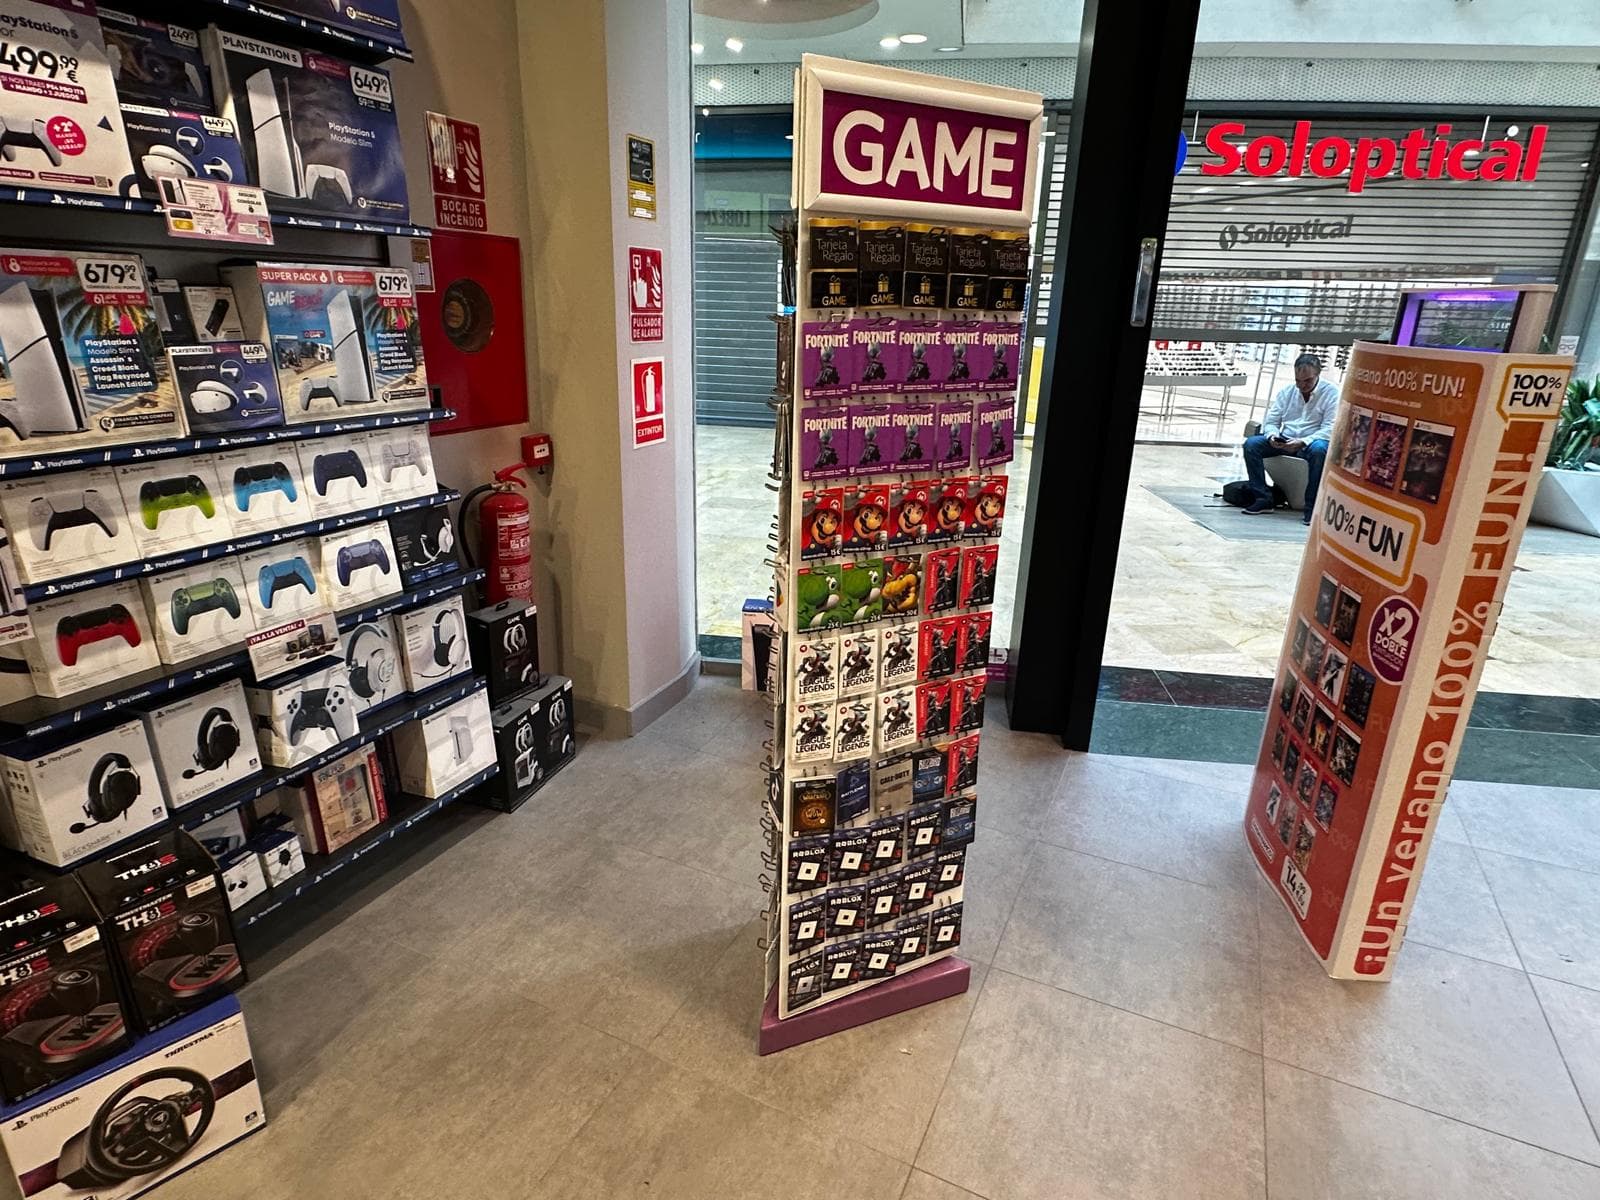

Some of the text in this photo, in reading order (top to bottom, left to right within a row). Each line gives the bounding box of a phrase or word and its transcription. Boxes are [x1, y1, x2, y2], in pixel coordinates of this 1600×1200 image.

[223, 36, 297, 63] PLAYSTATION 5
[328, 121, 376, 139] PlayStation 5
[330, 133, 373, 148] Modelo Slim
[833, 110, 1017, 199] GAME
[1201, 121, 1549, 193] Soloptical
[66, 197, 104, 207] PlayStation
[442, 199, 480, 215] BOCA DE
[440, 214, 484, 228] INCENDIO
[1241, 215, 1354, 247] Soloptical
[816, 239, 848, 251] Tarjeta
[864, 241, 895, 253] Tarjeta
[911, 243, 939, 255] Tarjeta
[822, 249, 854, 262] Regalo
[955, 245, 982, 258] Tarjeta
[996, 250, 1021, 262] Tarjeta
[871, 252, 901, 264] Regalo
[915, 254, 943, 266] Regalo
[959, 256, 986, 269] Regalo
[1000, 260, 1026, 271] Regalo
[84, 263, 125, 283] 679
[261, 271, 318, 281] SUPER PACK
[267, 290, 296, 307] GAME
[822, 296, 847, 306] GAME
[871, 294, 895, 304] GAME
[913, 295, 935, 305] GAME
[957, 297, 978, 307] GAME
[995, 300, 1016, 309] GAME
[633, 316, 662, 328] PULSADOR
[633, 328, 662, 338] DE ALARMA
[853, 331, 896, 345] FORTNITE
[899, 331, 941, 346] FORTNITE
[983, 332, 1018, 346] FORTNITE
[85, 338, 129, 347] PlayStation
[805, 333, 849, 349] FORTNITE
[87, 346, 134, 355] Modelo Slim
[92, 362, 139, 372] Creed Black
[94, 371, 150, 382] Flag Resynced
[1513, 374, 1562, 390] 100%
[96, 379, 153, 390] Launch Edition
[1383, 368, 1418, 391] 100%
[1421, 374, 1466, 398] FUN!
[1508, 391, 1552, 408] FUN
[852, 414, 890, 430] FORTNITE
[892, 413, 934, 427] FORTNITE
[940, 411, 971, 425] FORTNITE
[980, 408, 1013, 425] FORTNITE
[804, 416, 847, 432] FORTNITE
[637, 425, 663, 438] EXTINTOR
[146, 446, 177, 455] PlayStation
[47, 458, 83, 468] PlayStation
[1324, 495, 1404, 561] 100% FUN
[155, 558, 186, 569] PlayStation
[61, 578, 95, 591] PlayStation
[1375, 632, 1407, 659] DOBLE
[206, 662, 234, 675] PlayStation
[884, 661, 911, 671] LEAGUE
[884, 665, 915, 678] LEGENDS
[1386, 740, 1451, 884] verano
[1431, 602, 1490, 721] 100%
[1463, 453, 1535, 577] FUN!
[799, 676, 829, 687] LEAGUE
[843, 671, 870, 681] LEAGUE
[799, 683, 835, 694] LEGENDS
[842, 677, 874, 688] LEGENDS
[118, 691, 151, 705] PlayStation
[884, 725, 910, 736] LEAGUE
[884, 729, 914, 742] LEGENDS
[796, 736, 826, 746] LEAGUE
[838, 735, 865, 746] LEAGUE
[795, 742, 831, 753] LEGENDS
[837, 741, 870, 753] LEGENDS
[48, 747, 82, 762] PlayStation
[911, 812, 939, 826] ROBLOX
[872, 826, 900, 837] ROBLOX
[835, 838, 867, 848] ROBLOX
[793, 847, 825, 858] ROBLOX
[905, 868, 931, 881] ROBLOX
[870, 882, 898, 895] ROBLOX
[831, 895, 862, 906] ROBLOX
[866, 939, 894, 949] ROBLOX
[828, 949, 857, 961] ROBLOX
[30, 1096, 79, 1122] PlayStation
